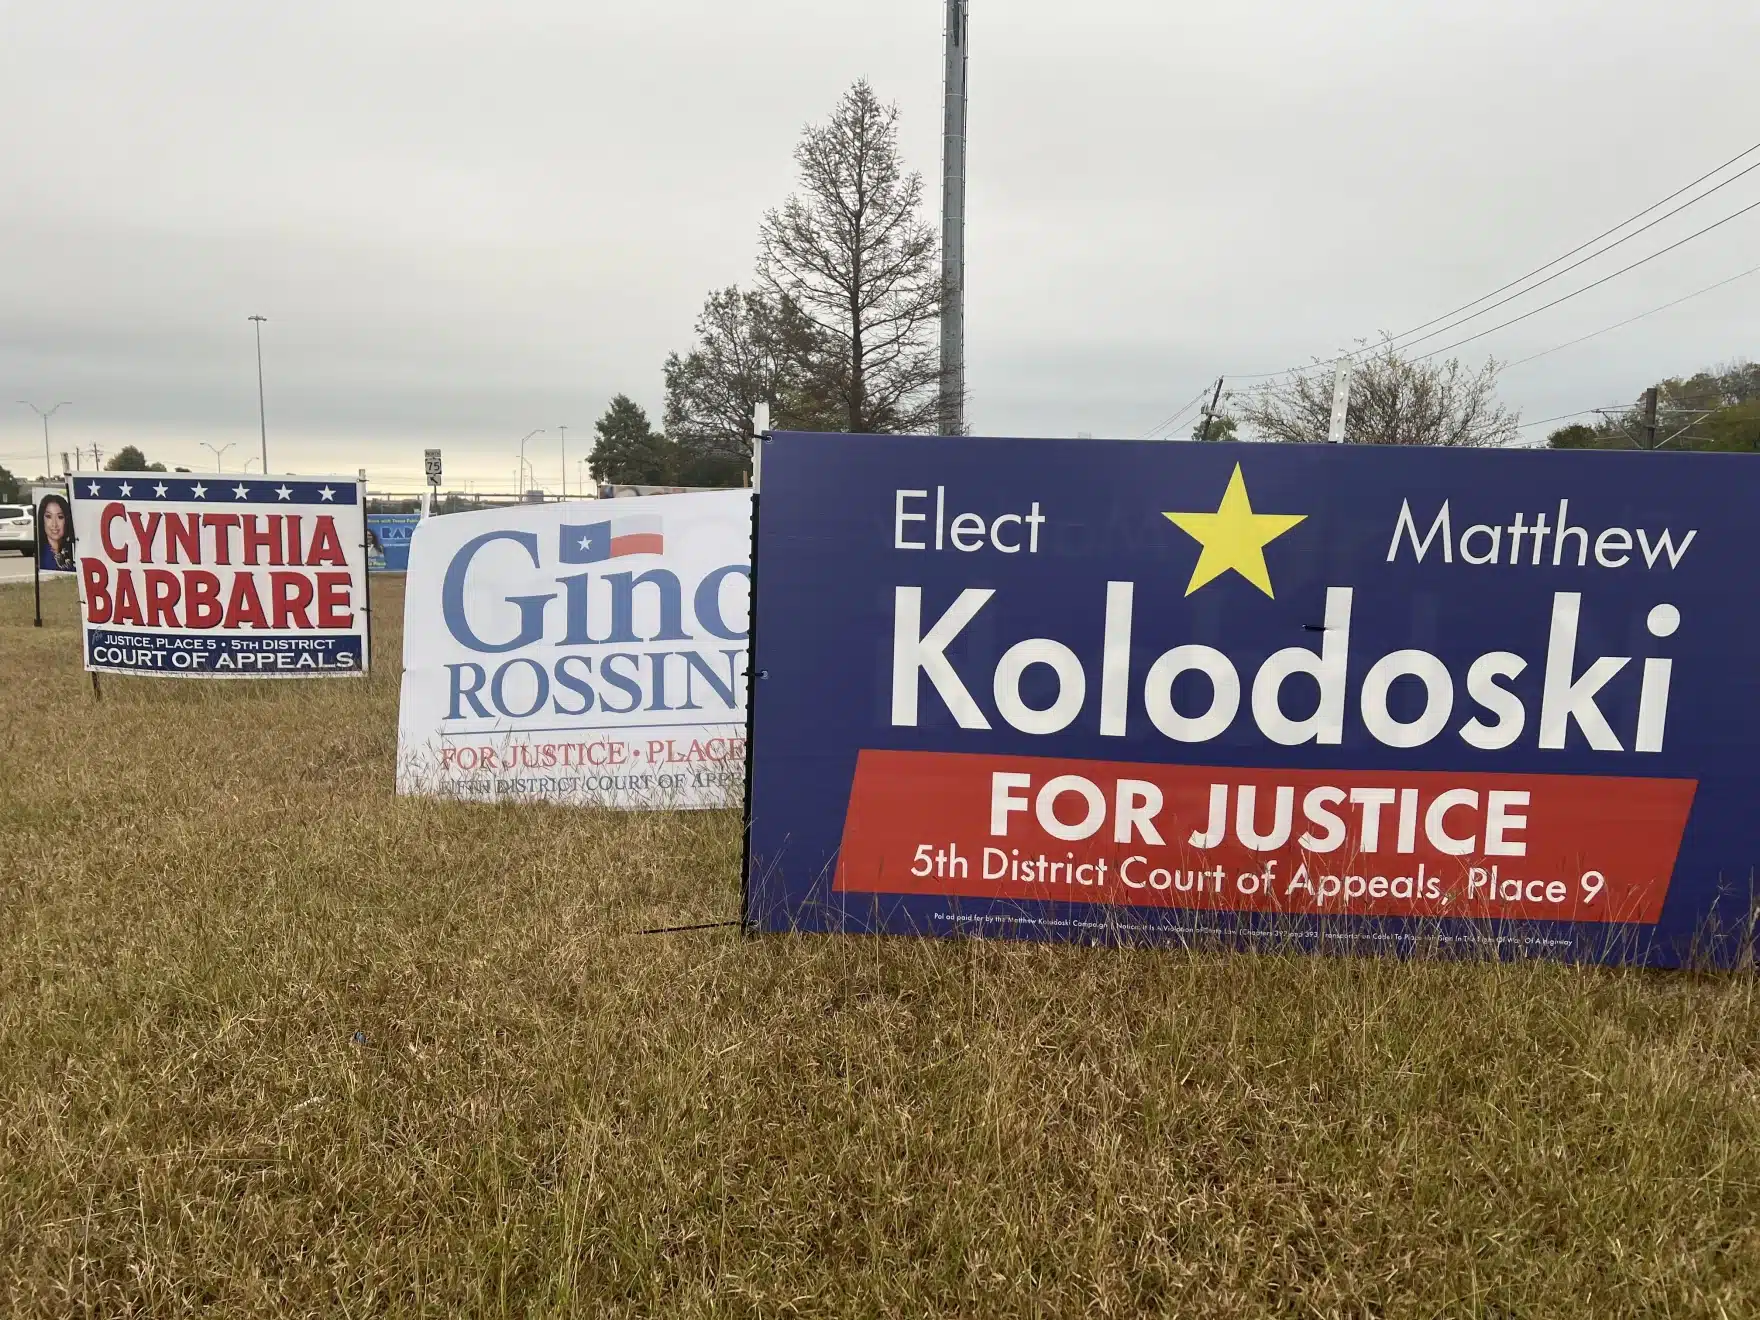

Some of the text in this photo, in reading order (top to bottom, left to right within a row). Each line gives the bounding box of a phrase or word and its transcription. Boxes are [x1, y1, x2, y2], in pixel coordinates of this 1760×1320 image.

[427, 461, 440, 471] 75
[100, 502, 348, 567] CYNTHIA
[895, 485, 1697, 569] Elect Matthew
[80, 557, 354, 630] BARBARE
[93, 646, 355, 670] COURT OF APPEALS
[105, 634, 336, 651] JUSTICE, PLACE 5 5TH DISTRICT
[892, 580, 1681, 753] Kolodoski
[442, 650, 744, 721] ROSSIN
[440, 779, 491, 795] FIFTH
[497, 776, 582, 794] DISTRICT
[585, 773, 652, 790] COURT
[658, 773, 686, 789] OF
[441, 738, 745, 770] FOR JUSTICE PLACE
[991, 771, 1530, 857] FOR JUSTICE
[911, 843, 1604, 907] 5th District Court of Appeals, Place 9
[934, 912, 944, 920] Pol
[956, 914, 972, 922] paid
[974, 914, 983, 922] for
[985, 914, 994, 923] by
